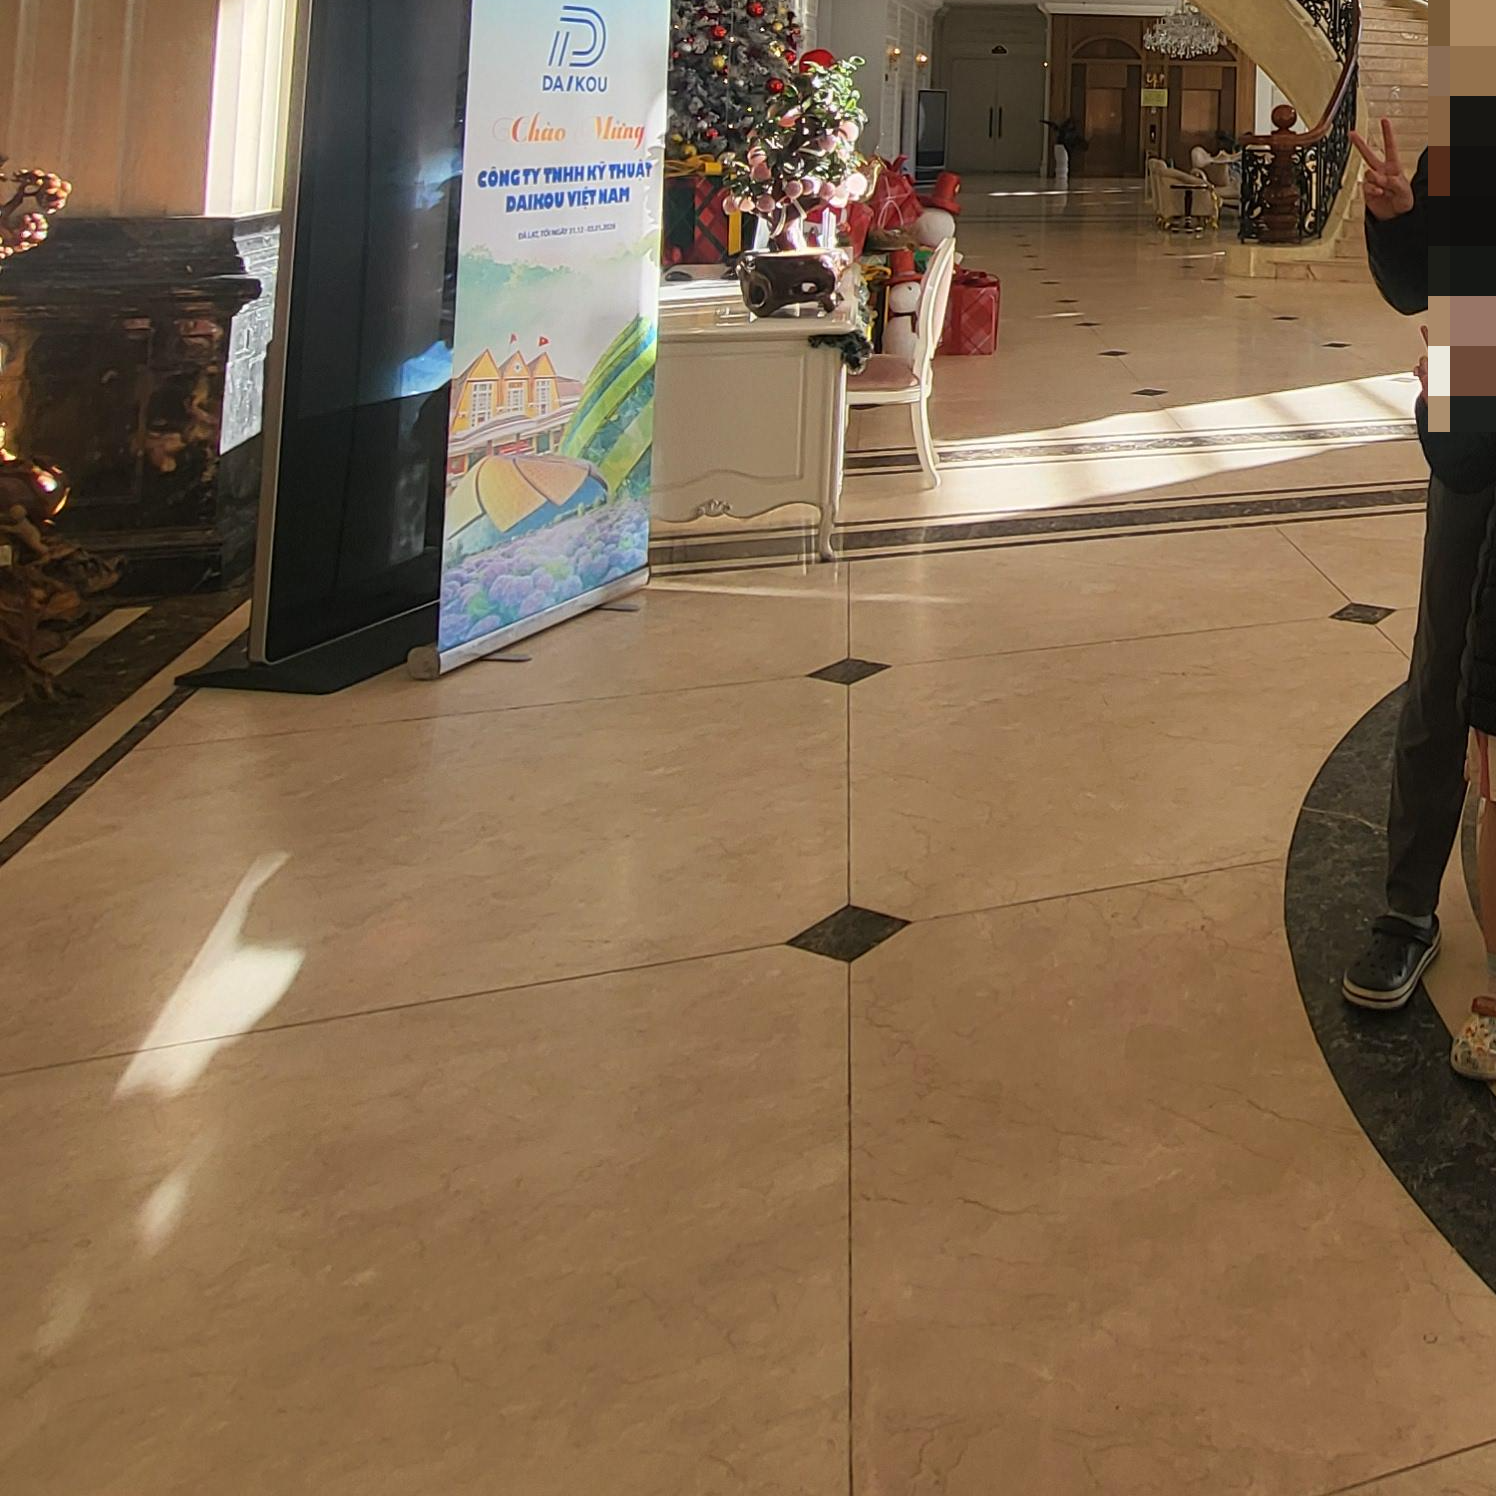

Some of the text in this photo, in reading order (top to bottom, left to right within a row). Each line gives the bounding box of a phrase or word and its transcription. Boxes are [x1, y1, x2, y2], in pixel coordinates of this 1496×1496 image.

[541, 75, 608, 93] DAIKOU
[477, 166, 520, 188] CÔNG
[522, 167, 541, 185] TY
[543, 165, 585, 184] TNHH
[608, 159, 653, 181] THUẬT
[505, 186, 630, 213] DAIKOU VIỆT NAM
